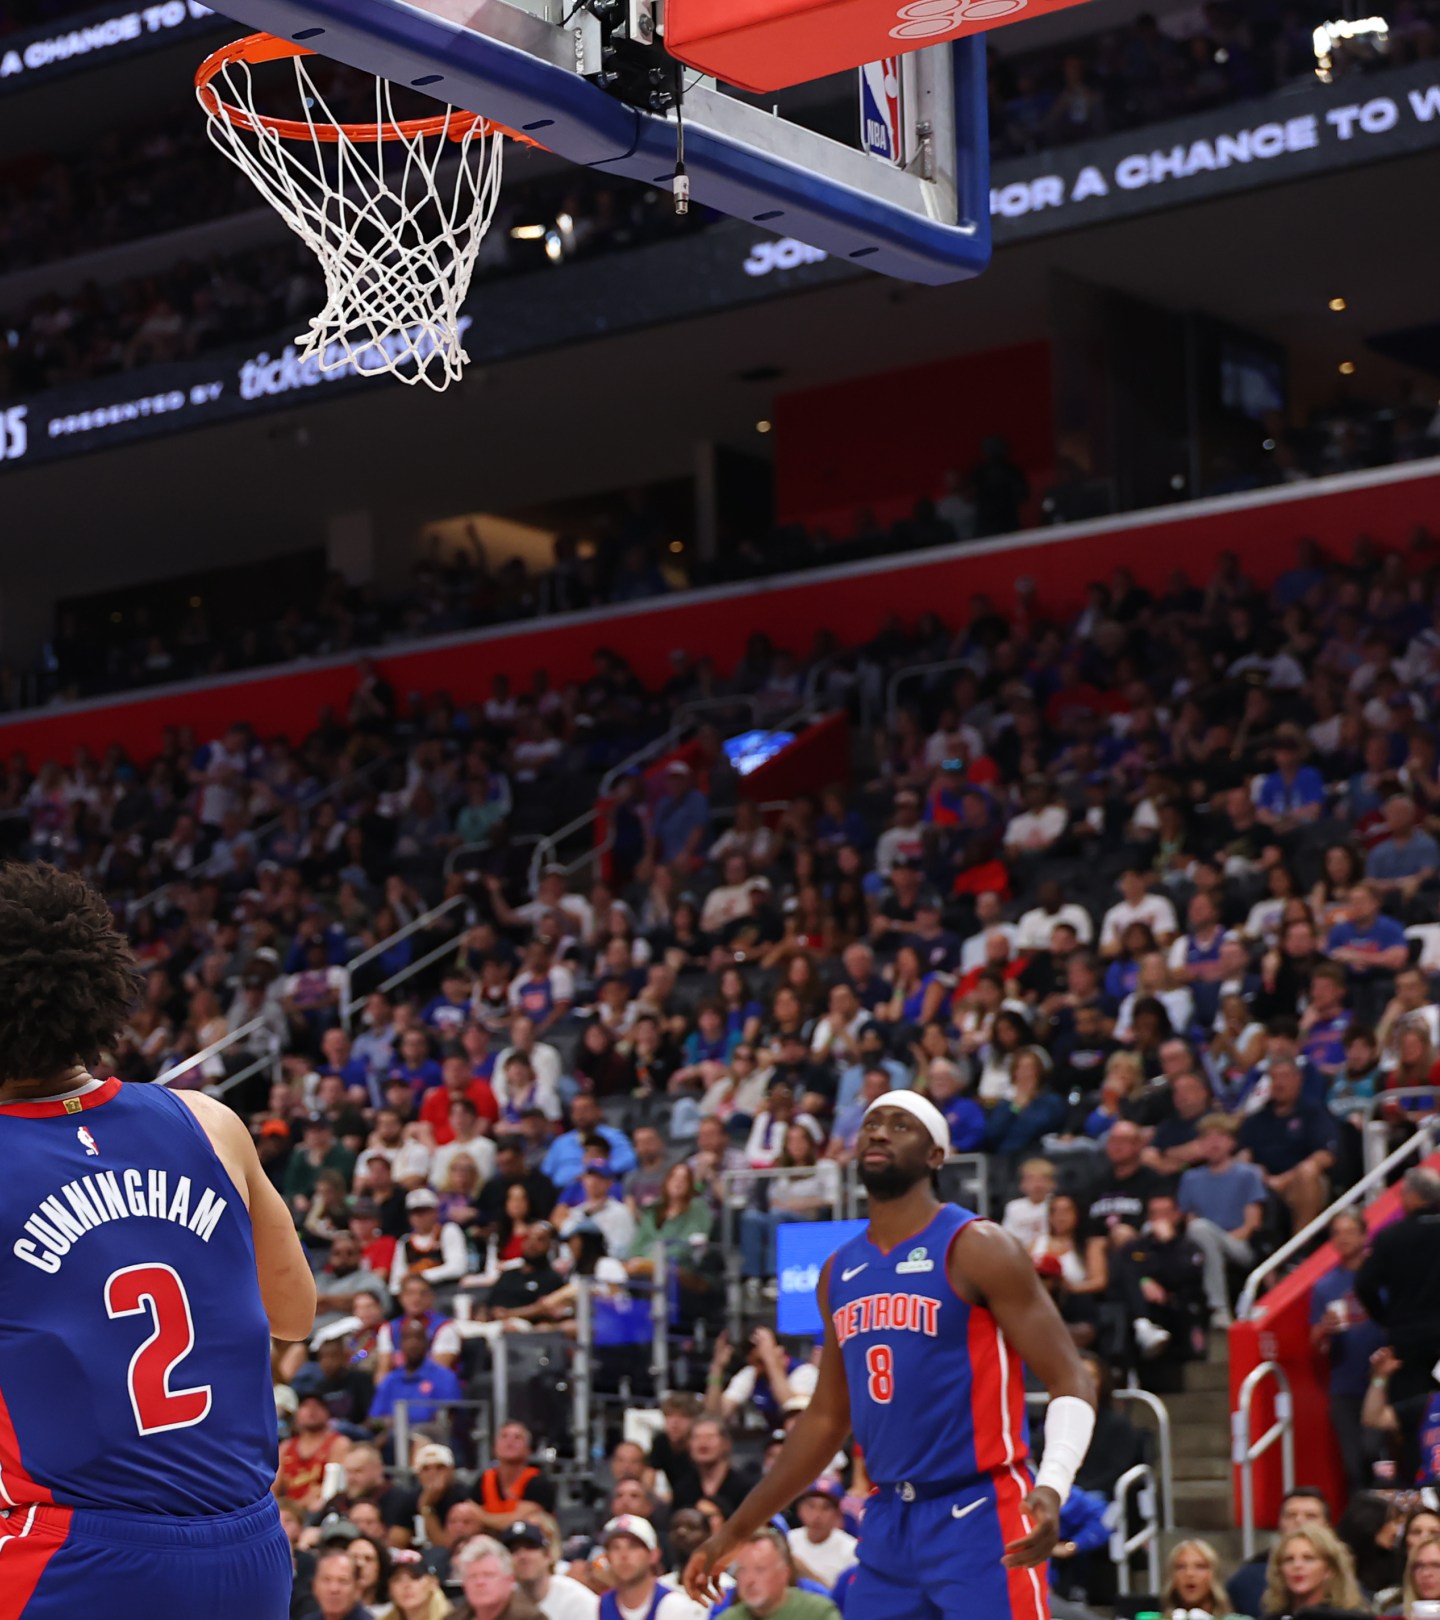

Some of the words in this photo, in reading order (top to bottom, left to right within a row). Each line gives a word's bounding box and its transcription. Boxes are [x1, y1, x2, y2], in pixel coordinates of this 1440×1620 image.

[0, 51, 23, 76] A
[24, 13, 142, 68] CHANCE
[141, 1, 186, 31] TO
[867, 119, 887, 150] NBA
[1071, 167, 1108, 201] A
[1115, 115, 1318, 189] CHANCE
[1326, 98, 1398, 140] TO
[744, 237, 827, 275] JO
[48, 391, 185, 437] PRESENTED
[190, 382, 223, 405] BY
[13, 1169, 227, 1275] CUNNINGHAM
[104, 1262, 212, 1436] 2
[832, 1293, 942, 1348] DETROIT
[865, 1344, 894, 1404] 8
